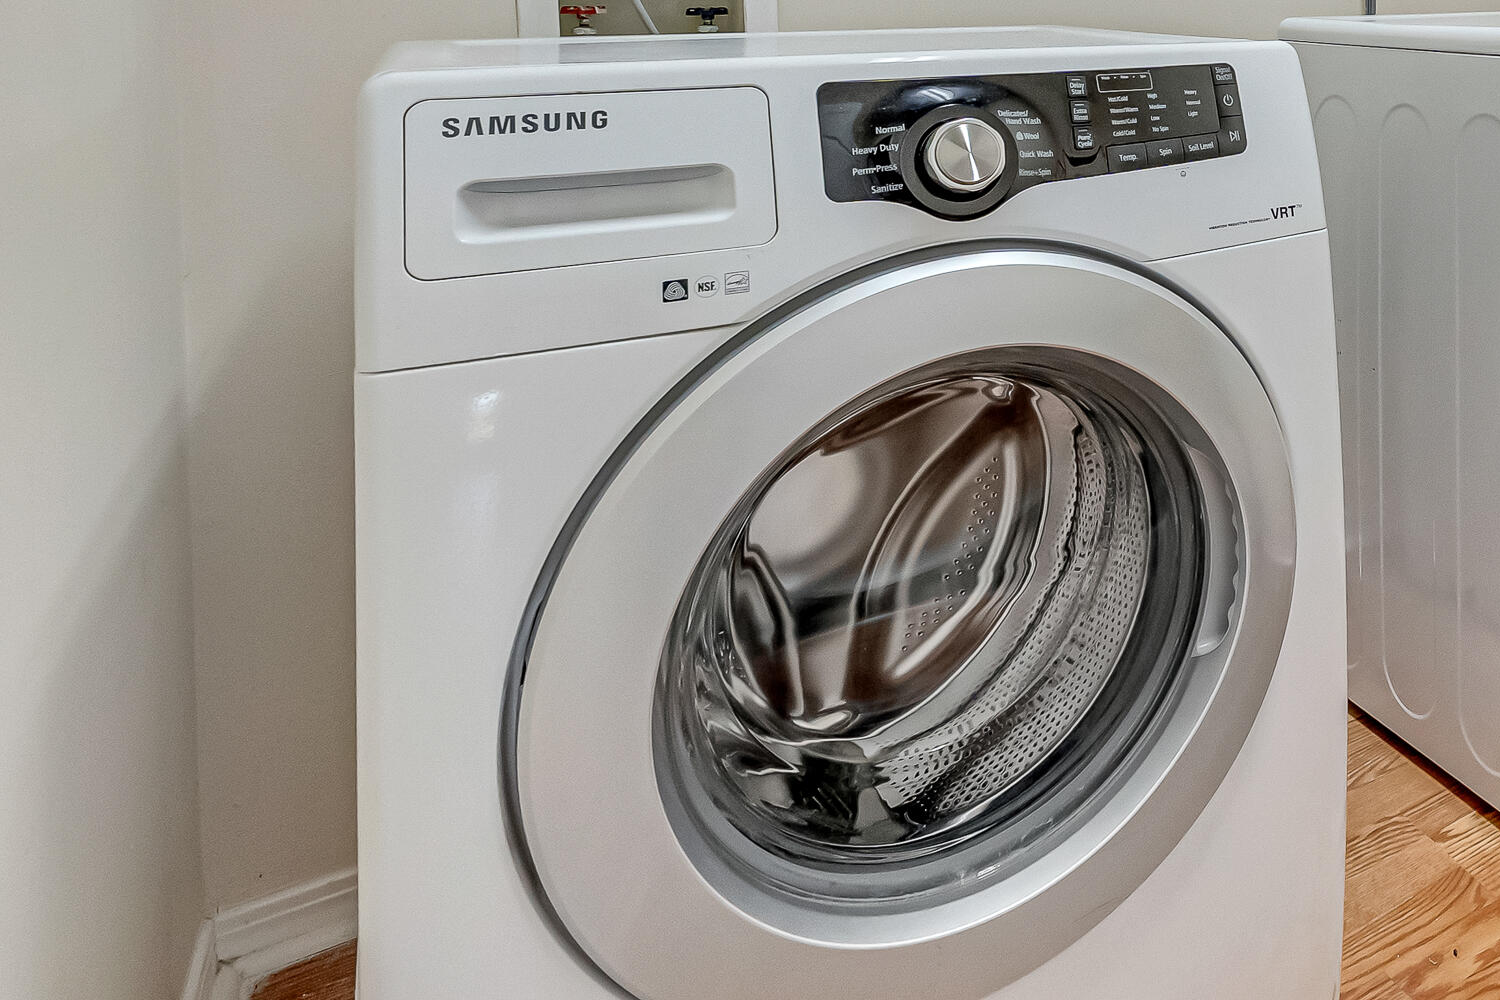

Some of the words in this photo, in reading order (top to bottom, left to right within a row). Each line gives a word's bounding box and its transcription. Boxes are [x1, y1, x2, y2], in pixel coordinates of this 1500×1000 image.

[441, 109, 609, 139] SAMSUNG
[1023, 117, 1041, 125] Wash
[875, 123, 906, 135] Normal
[1023, 132, 1040, 140] Wool
[852, 146, 878, 157] Heavy
[880, 143, 899, 155] Duty
[1159, 147, 1173, 156] Spin
[1188, 143, 1200, 152] Soil
[1200, 141, 1214, 150] Level
[1020, 150, 1036, 158] Quick
[1036, 149, 1054, 157] Wash
[871, 182, 904, 195] Sanitize
